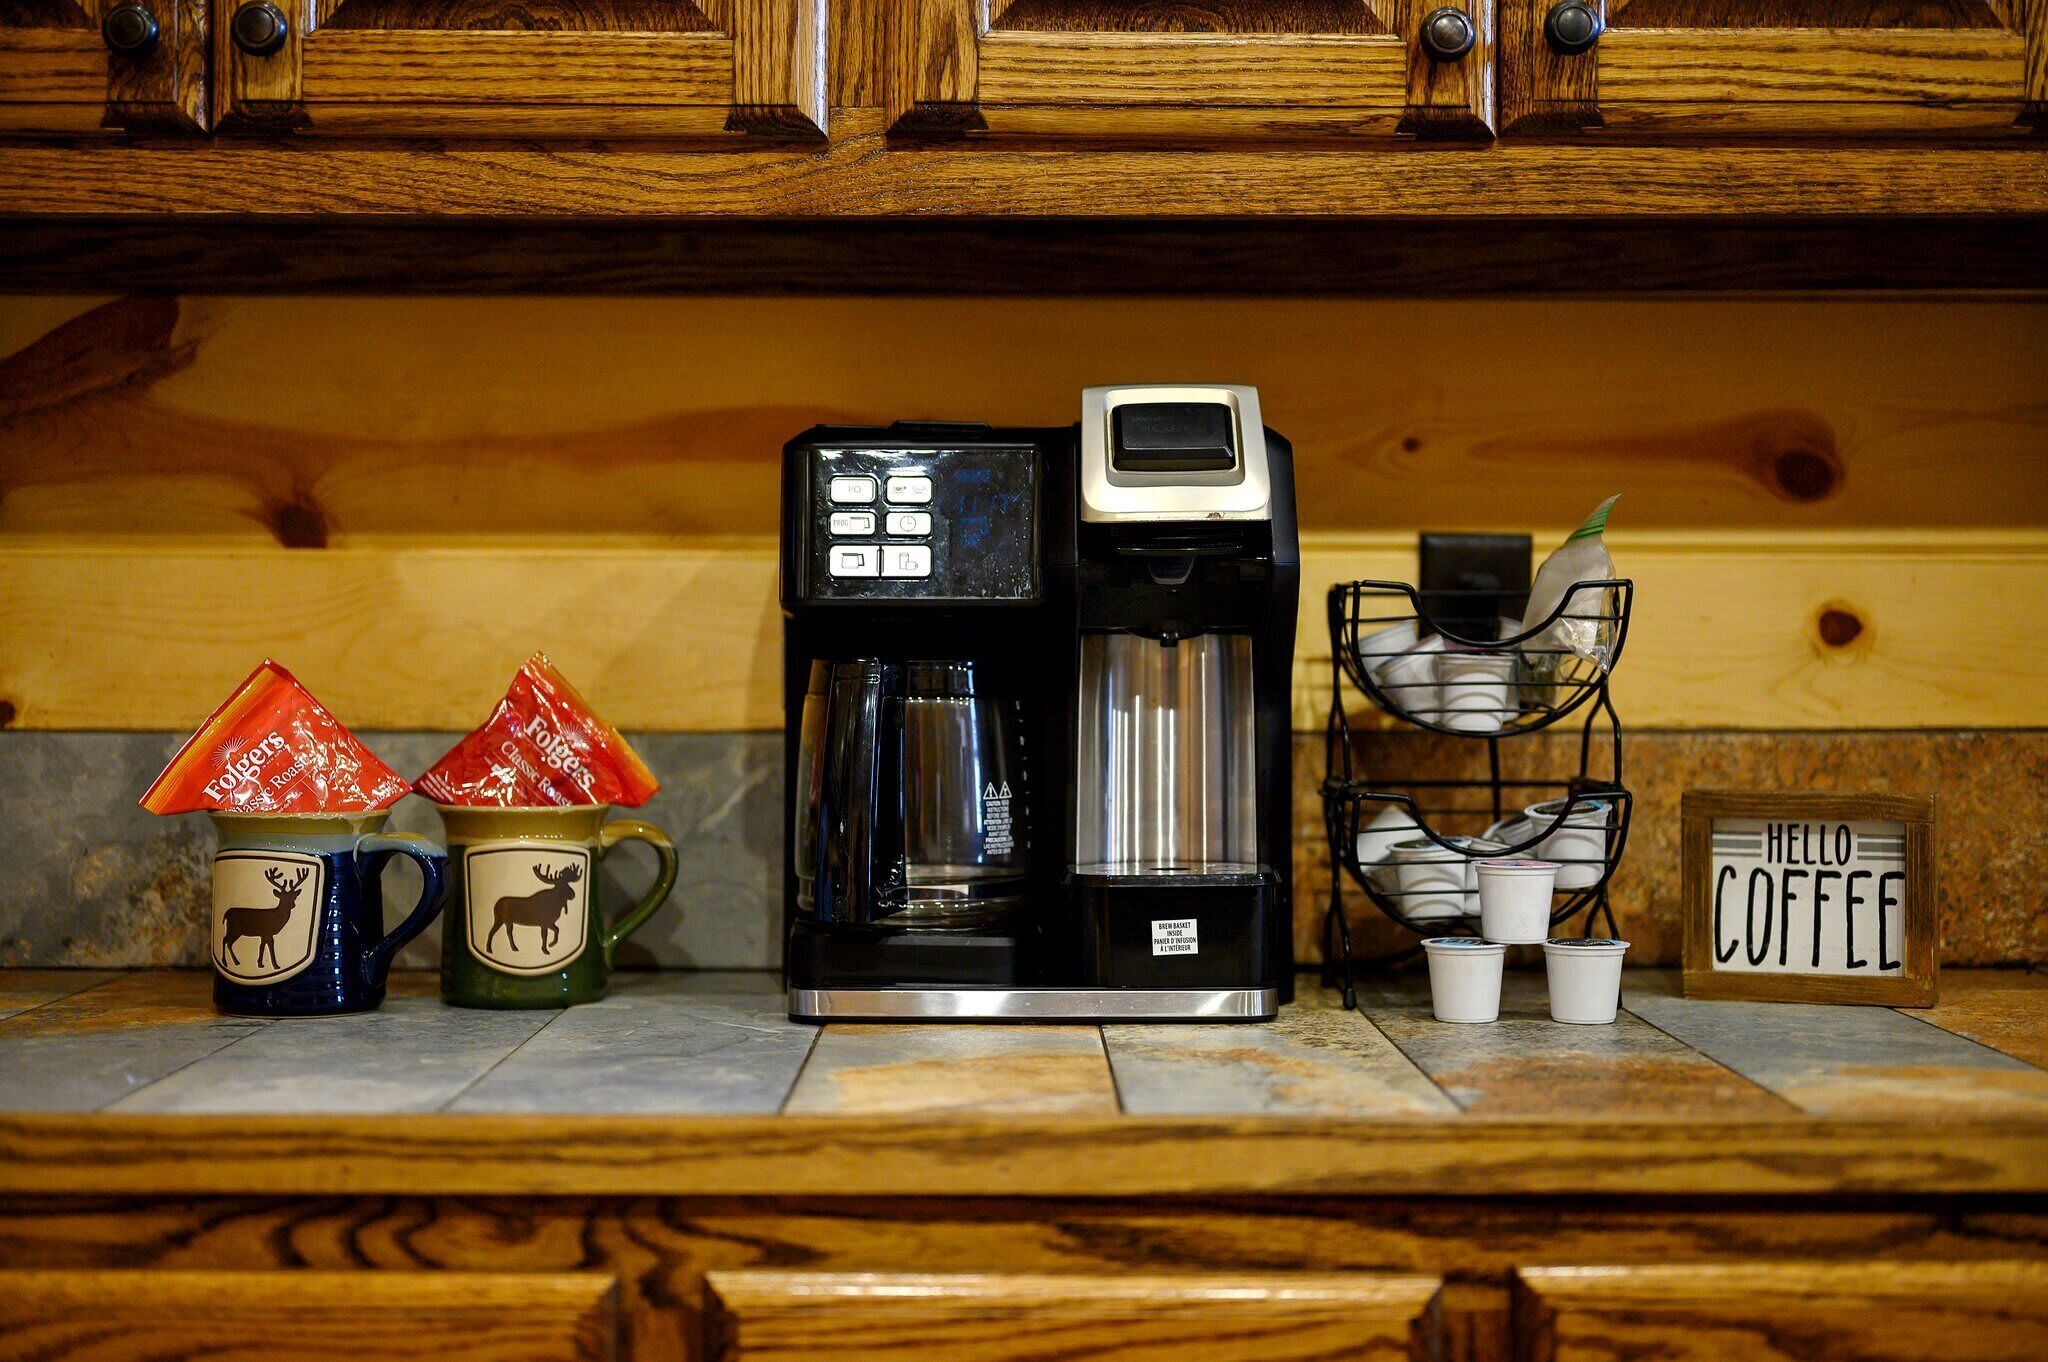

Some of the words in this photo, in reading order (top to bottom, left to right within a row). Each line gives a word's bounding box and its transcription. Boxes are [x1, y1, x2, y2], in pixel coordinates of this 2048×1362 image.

[833, 519, 849, 527] PROG
[202, 731, 285, 802] Folgers
[269, 756, 309, 790] Roast
[501, 741, 540, 783] Classic
[525, 714, 595, 789] Folgers
[1767, 823, 1852, 866] HELLO
[1714, 865, 1905, 970] COFFEE
